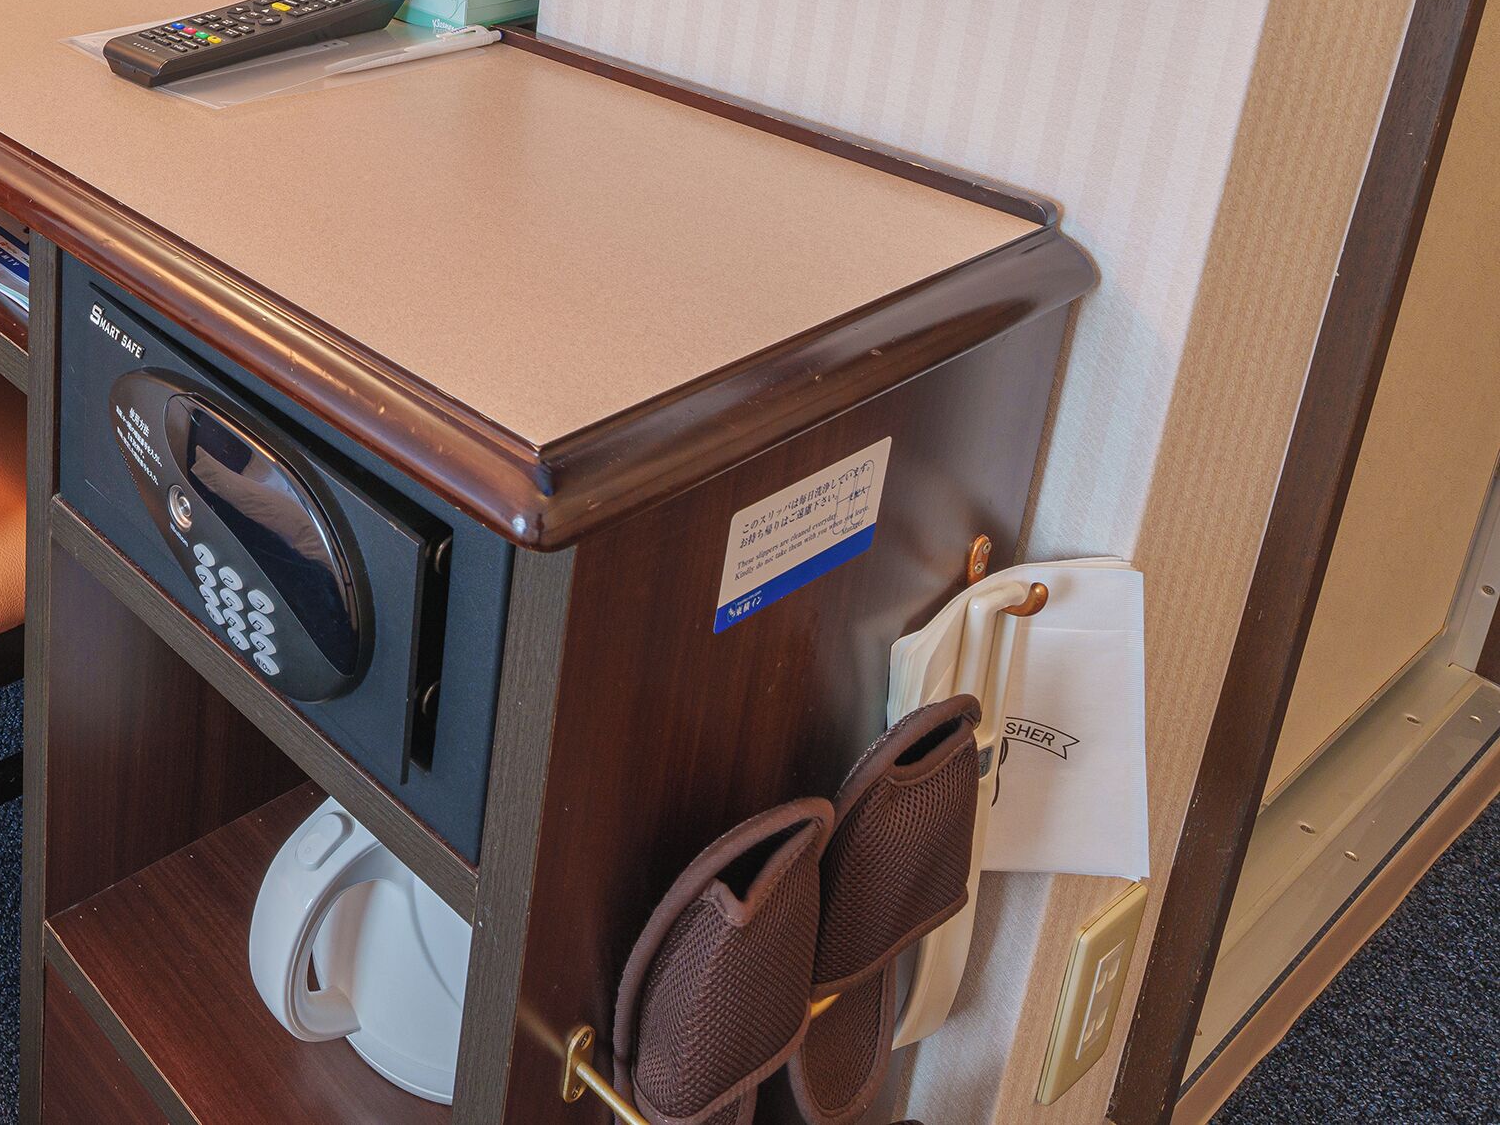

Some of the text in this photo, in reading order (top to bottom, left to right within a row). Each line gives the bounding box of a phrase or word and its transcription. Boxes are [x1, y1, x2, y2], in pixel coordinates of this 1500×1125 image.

[90, 304, 142, 359] SMART SAFE
[734, 565, 754, 581] Kindly
[756, 561, 764, 570] do
[775, 548, 788, 559] take
[788, 541, 803, 553] them
[804, 532, 817, 543] with
[817, 528, 828, 539] you
[737, 557, 755, 569] These
[756, 544, 779, 560] slippers
[779, 538, 789, 548] are
[1004, 722, 1056, 747] SHER
